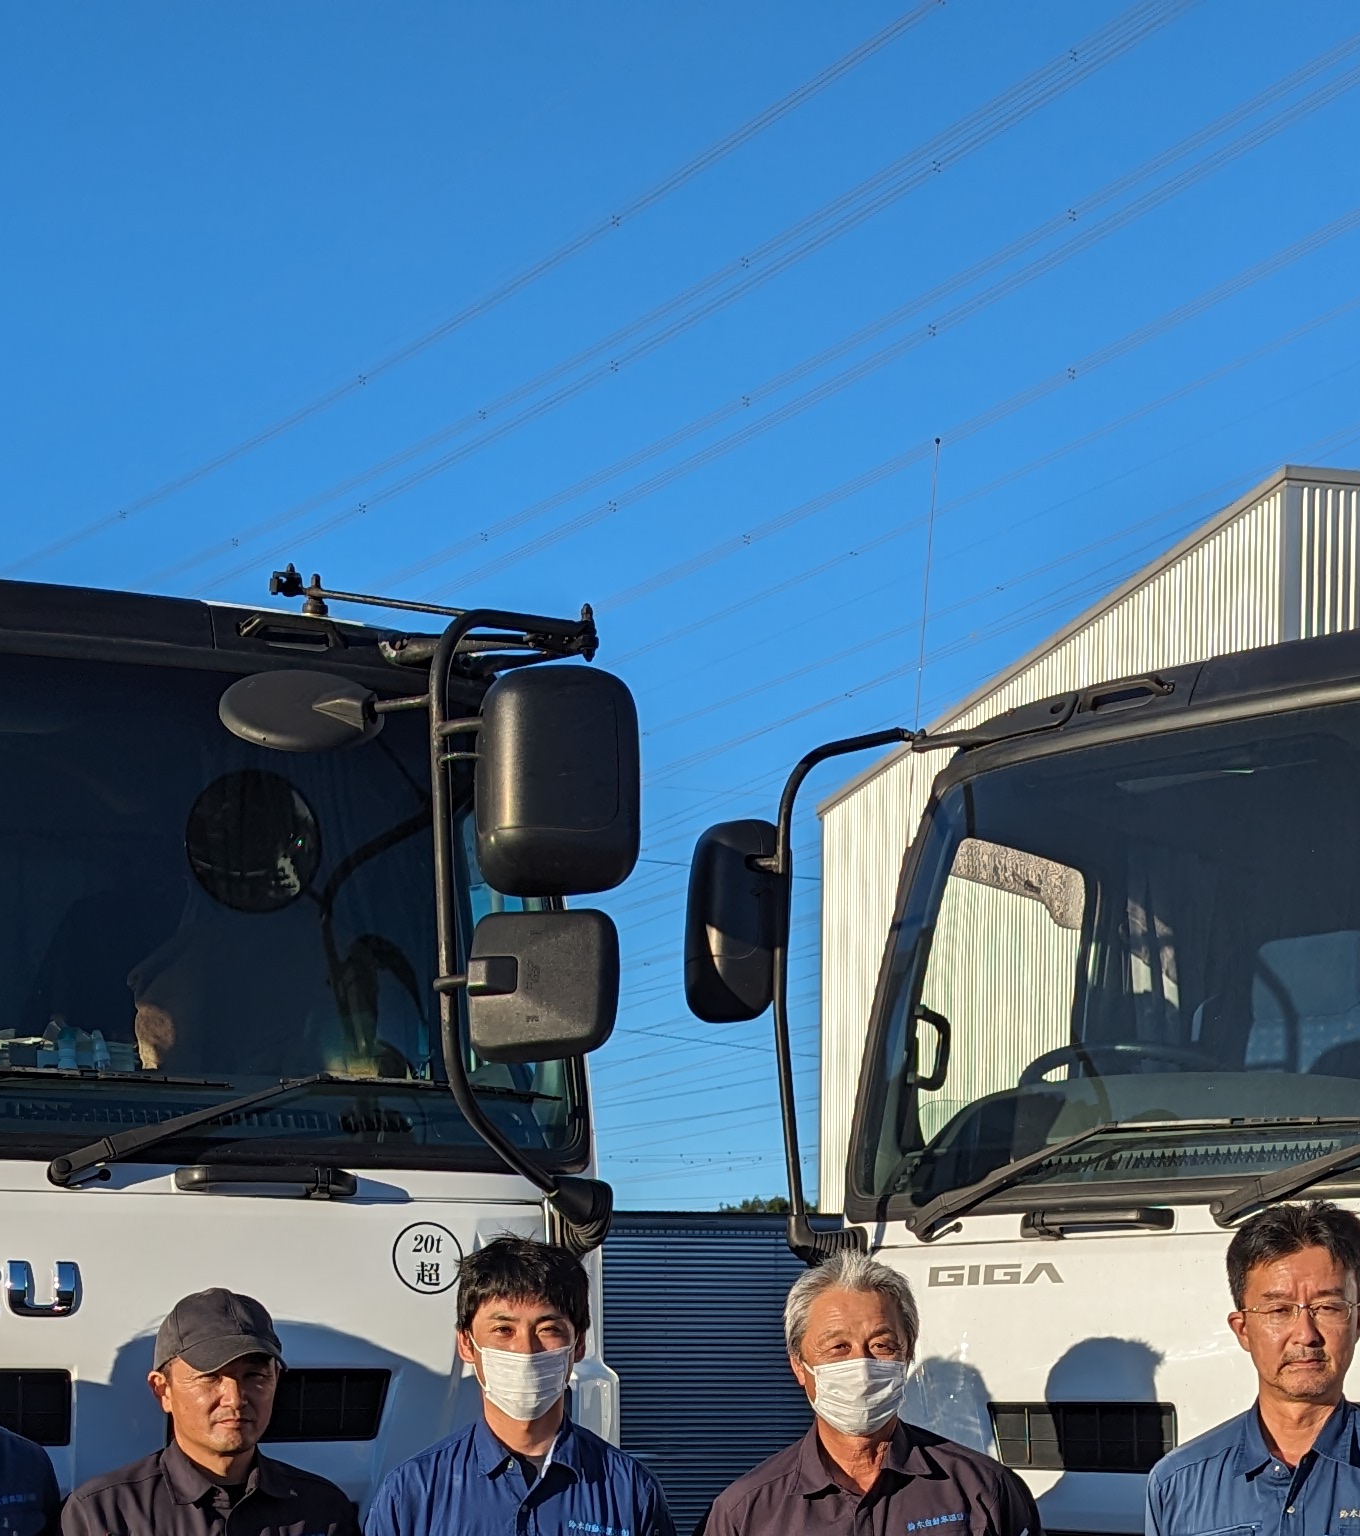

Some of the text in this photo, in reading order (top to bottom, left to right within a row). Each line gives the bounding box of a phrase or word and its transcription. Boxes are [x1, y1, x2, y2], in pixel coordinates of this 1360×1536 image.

[412, 1234, 443, 1253] 20t
[415, 1261, 441, 1286] 超
[928, 1262, 1064, 1287] GIGA
